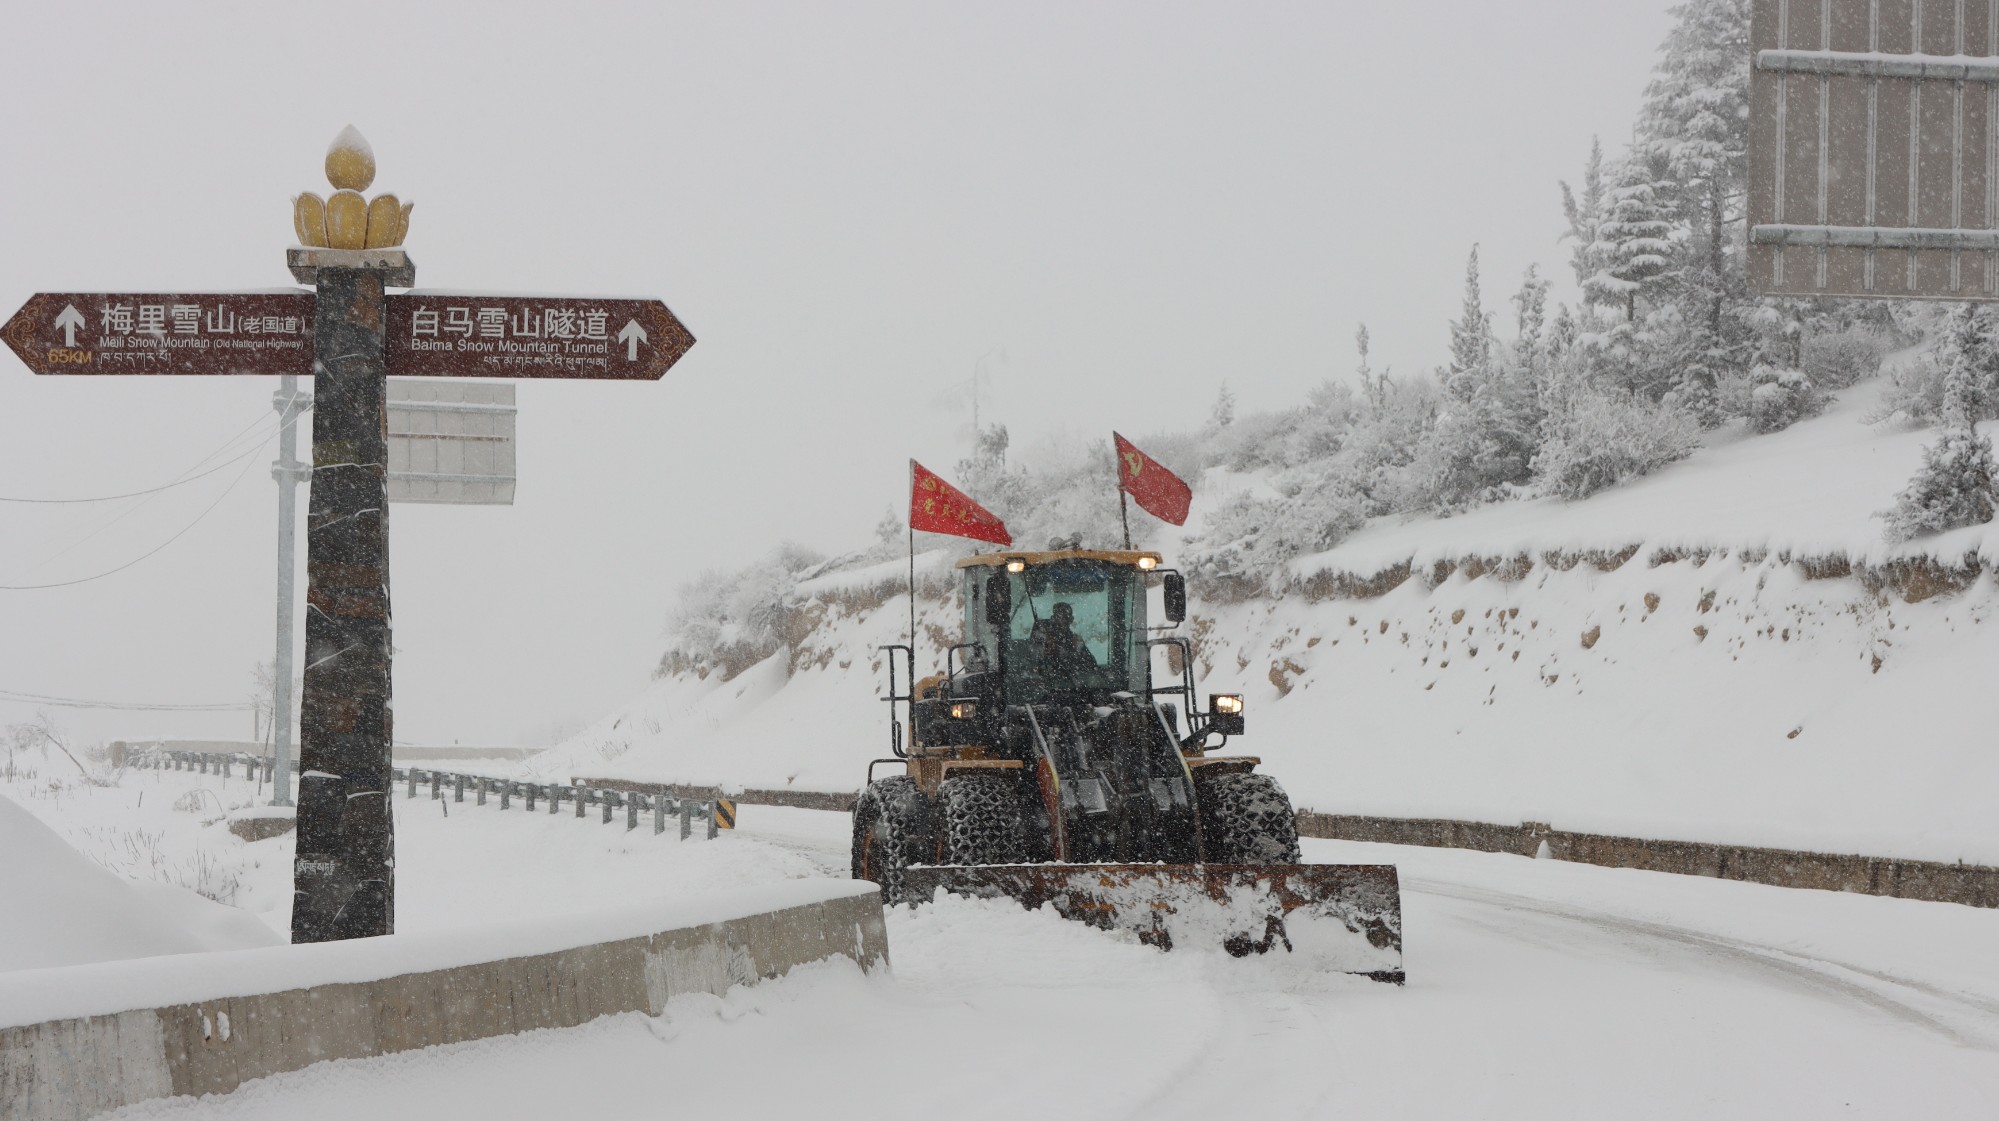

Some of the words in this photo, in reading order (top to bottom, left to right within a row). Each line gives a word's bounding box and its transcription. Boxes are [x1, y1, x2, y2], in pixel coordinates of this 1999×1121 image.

[411, 306, 609, 340] 白马雪山隧道
[100, 337, 124, 348] Meili
[127, 337, 159, 348] Snow
[160, 337, 210, 348] Mountain
[213, 339, 230, 350] (Old
[231, 339, 265, 350] National
[266, 339, 304, 351] Highway)
[411, 339, 453, 351] Baima
[458, 340, 494, 351] Snow
[498, 340, 559, 353] Mountain
[562, 341, 608, 354] Tunnel
[48, 348, 92, 364] 65KM
